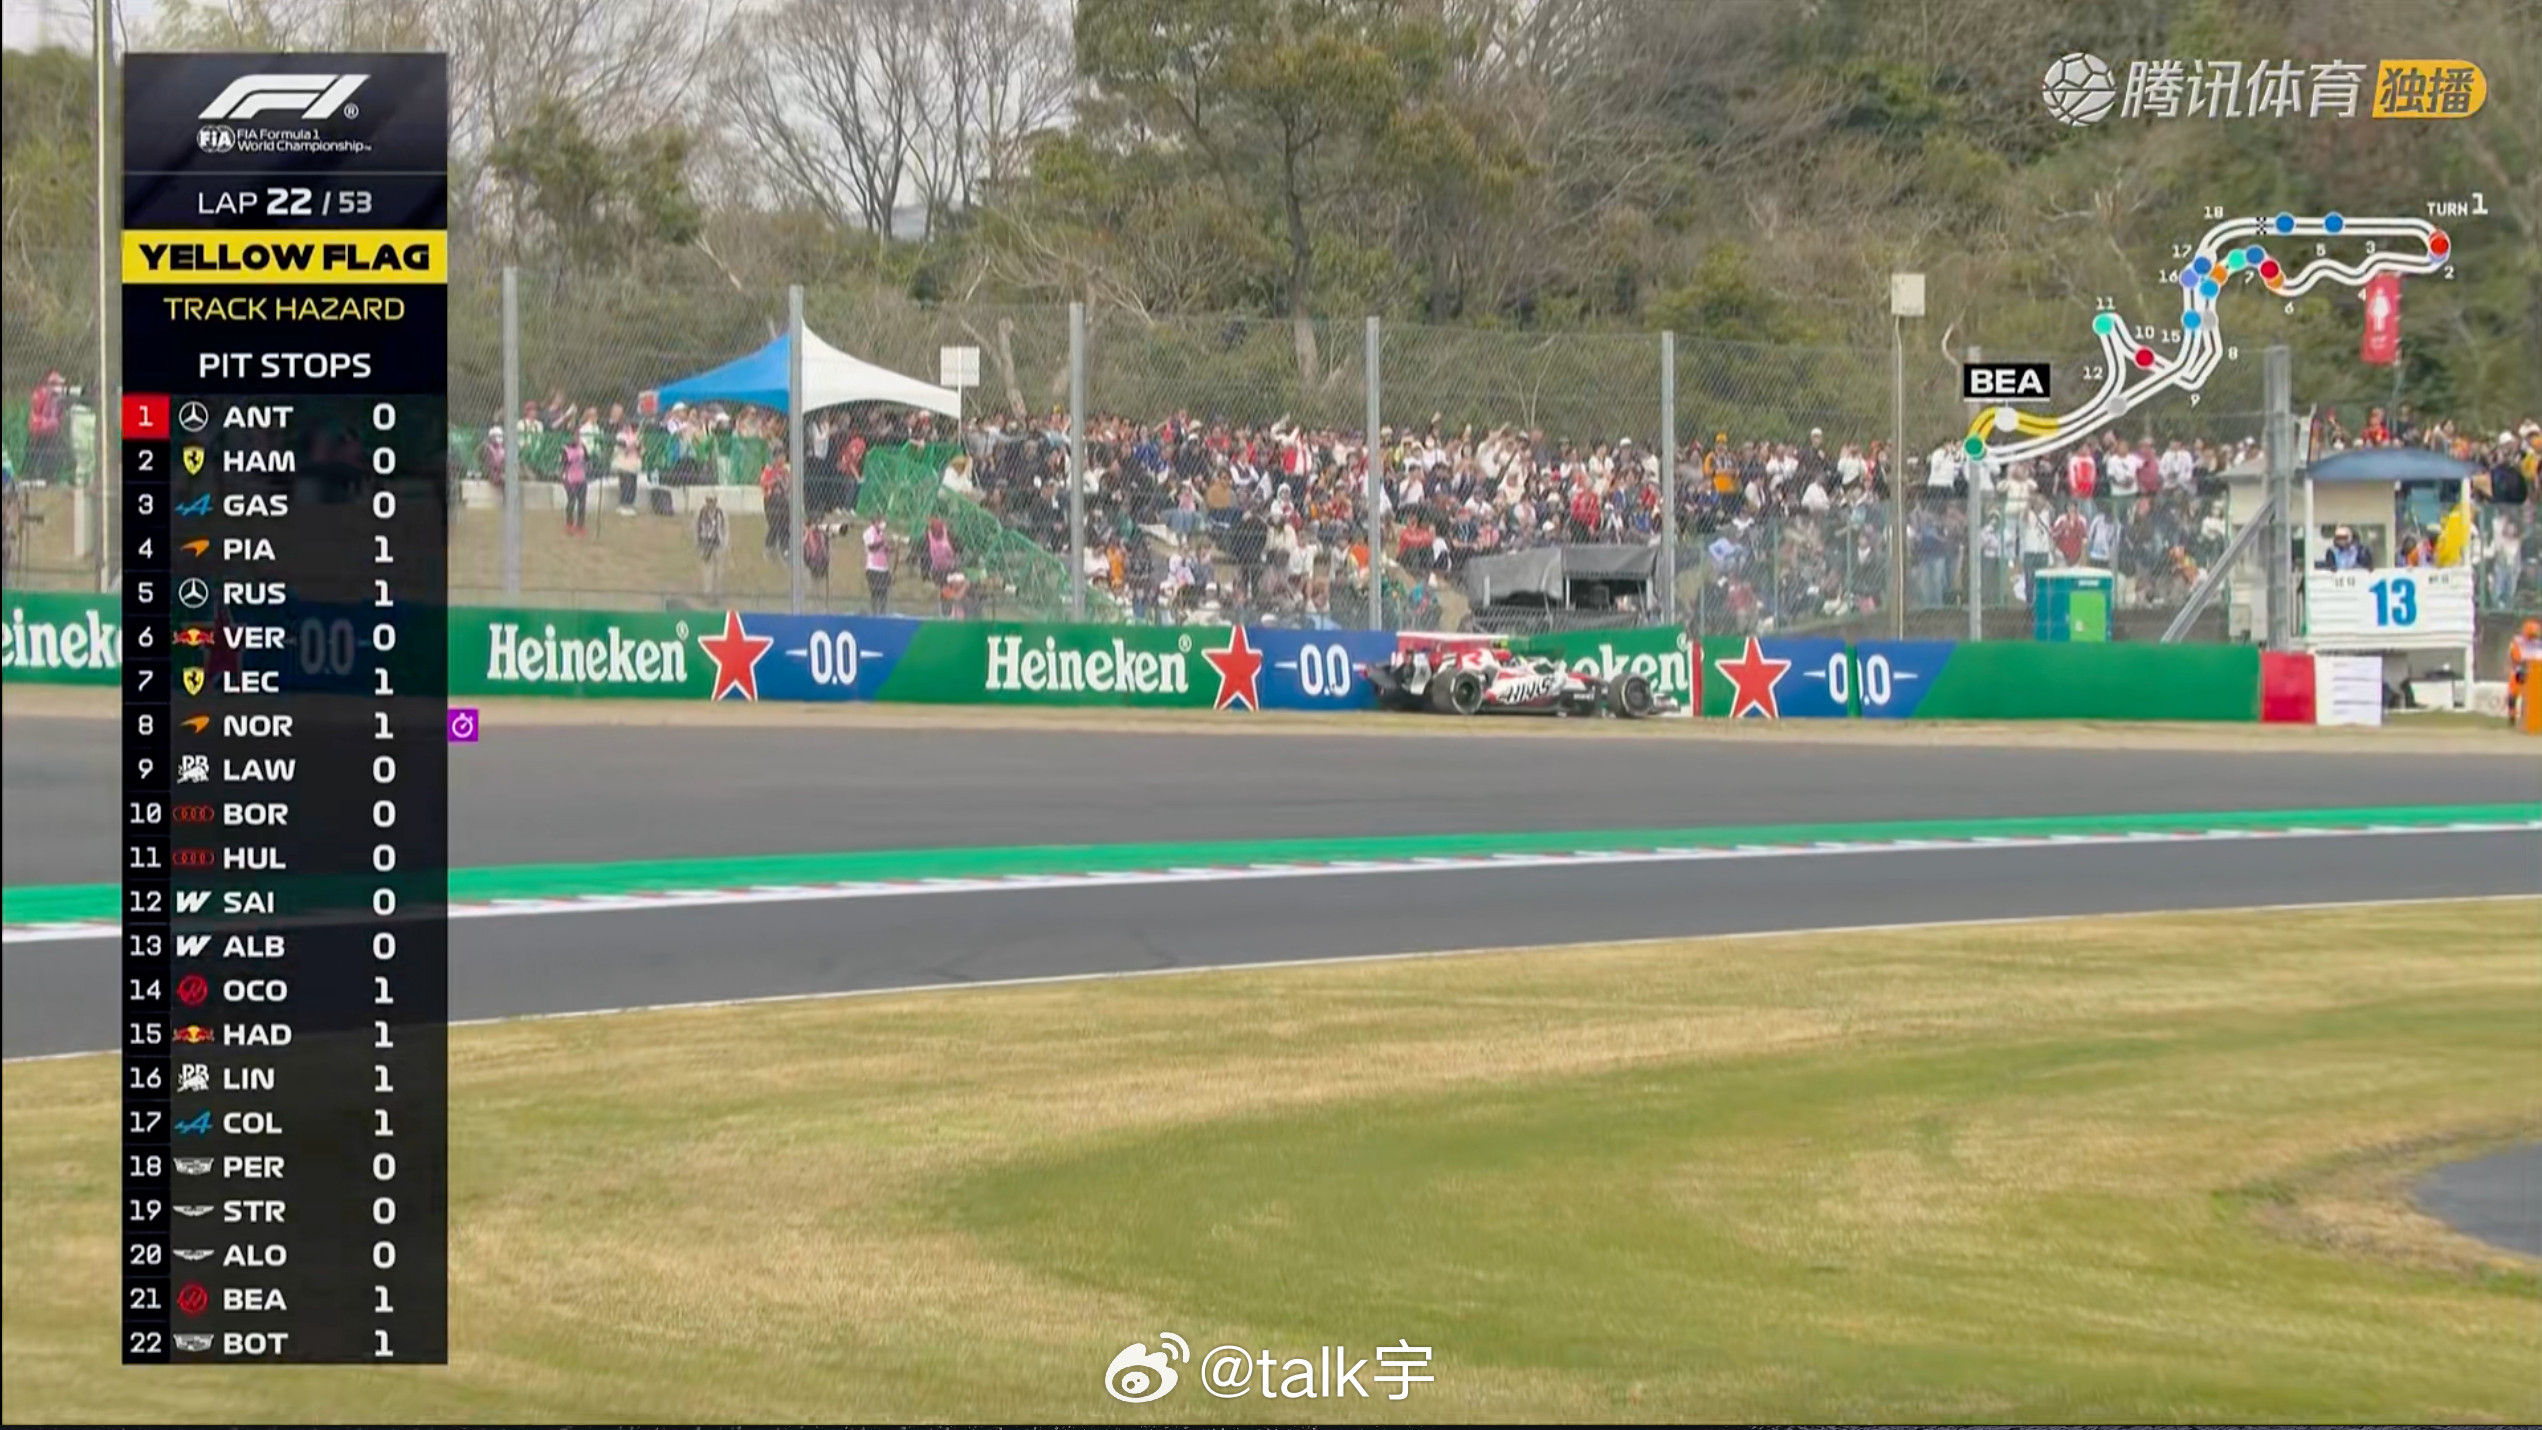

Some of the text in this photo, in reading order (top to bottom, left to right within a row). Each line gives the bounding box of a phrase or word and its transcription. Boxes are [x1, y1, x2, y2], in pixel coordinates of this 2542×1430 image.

[2369, 578, 2417, 626] 13
[809, 630, 857, 684] 0.0
[1300, 644, 1351, 696] 0.0
